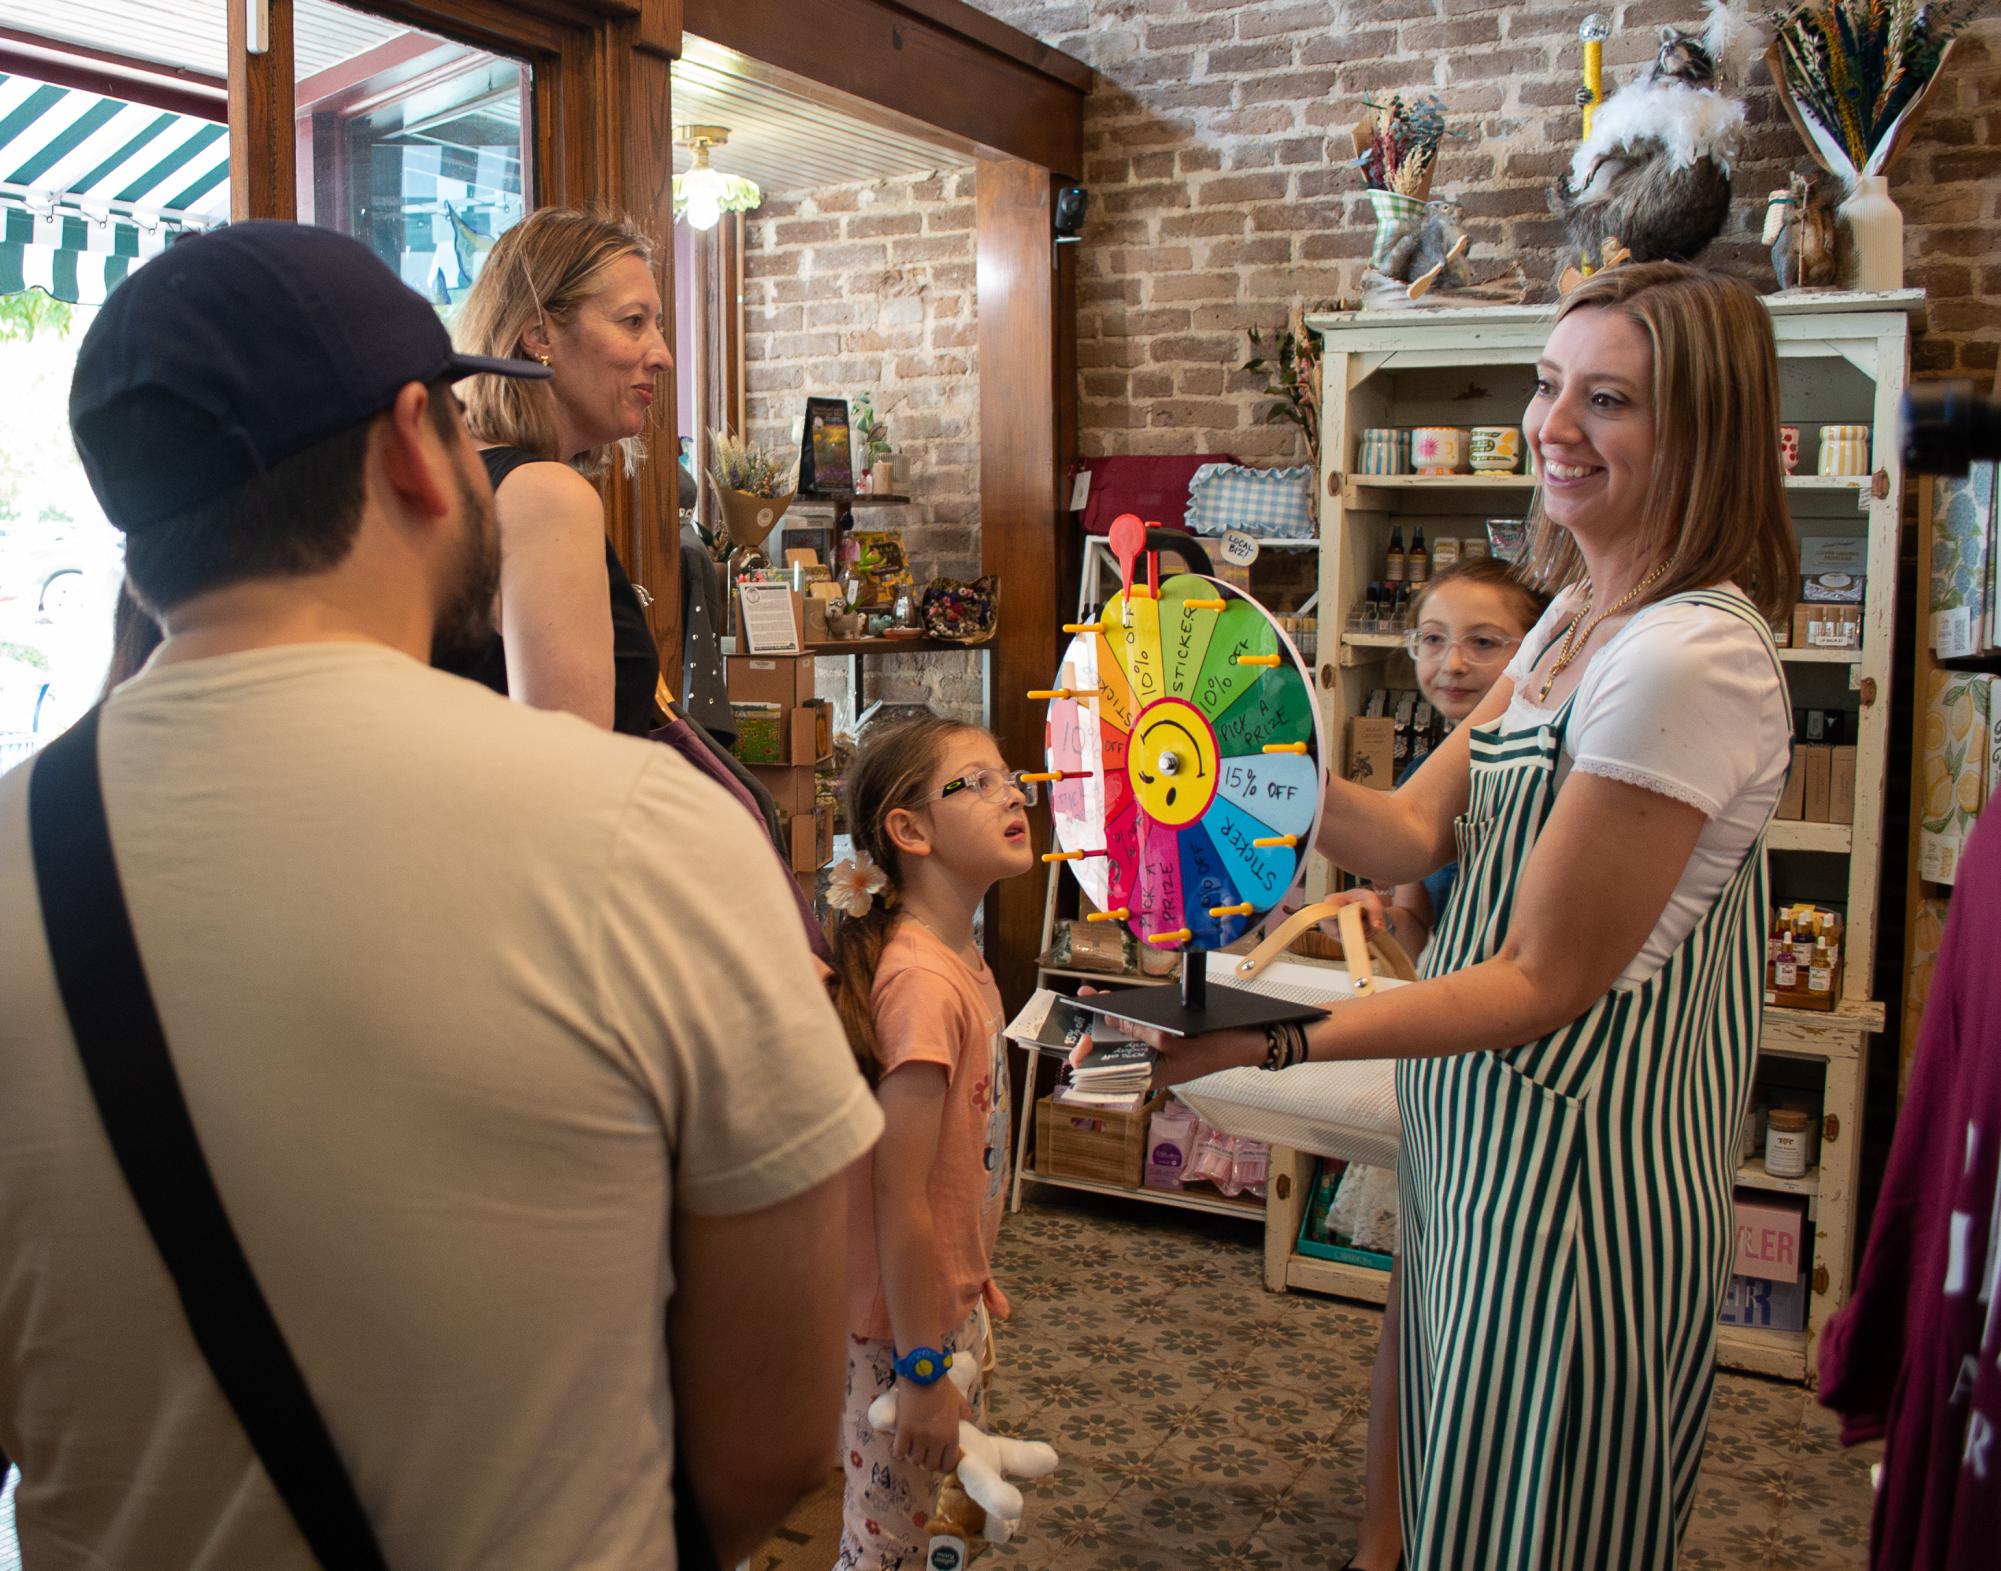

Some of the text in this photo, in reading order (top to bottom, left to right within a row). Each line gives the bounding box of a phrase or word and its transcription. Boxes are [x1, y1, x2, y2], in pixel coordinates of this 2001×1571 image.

[1228, 534, 1253, 551] LOCAL
[1199, 674, 1233, 714] 10%
[1220, 699, 1270, 742] PICK A
[1245, 706, 1292, 748] PRIZE
[1104, 740, 1125, 754] OFF
[1225, 766, 1299, 801] 15% OFF
[1220, 815, 1277, 892] STICKER
[1160, 861, 1176, 922] PRIZE
